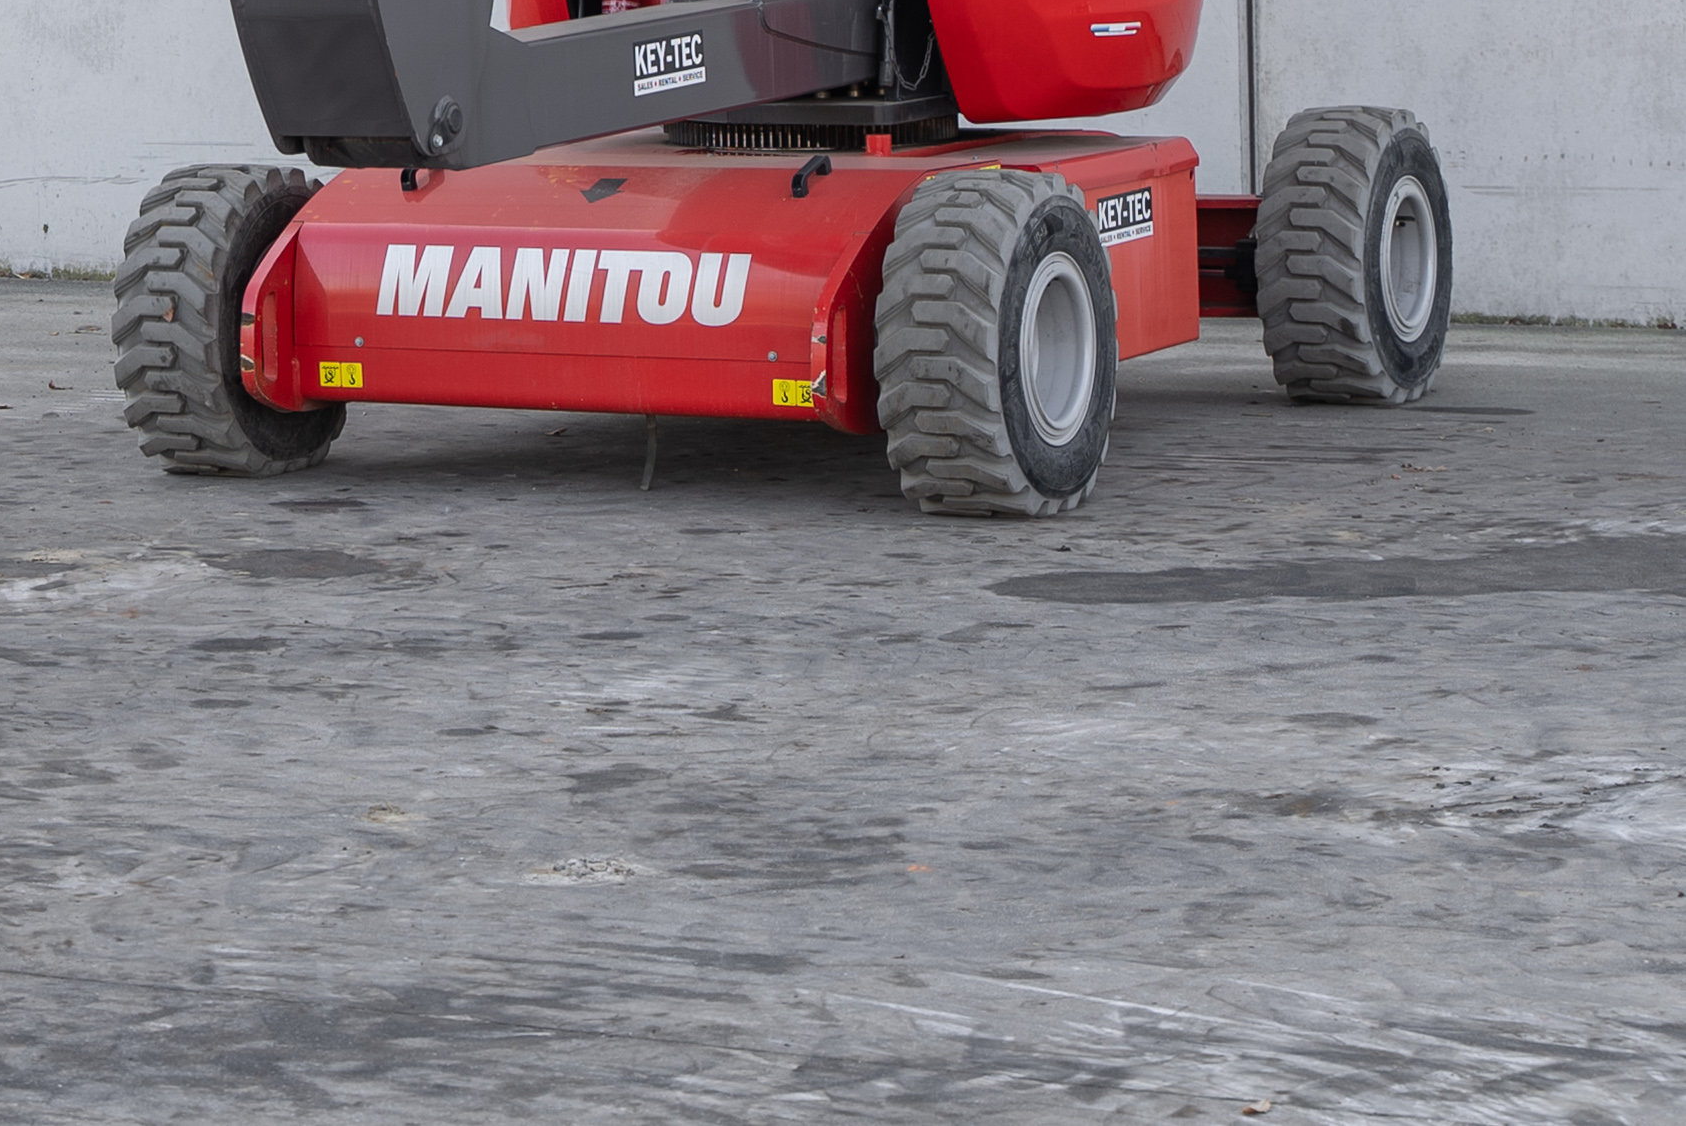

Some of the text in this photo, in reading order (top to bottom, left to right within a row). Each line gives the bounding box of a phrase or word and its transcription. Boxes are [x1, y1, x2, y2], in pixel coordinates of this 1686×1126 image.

[635, 34, 703, 77] KEY-TEC
[1098, 191, 1151, 231] KEY-TEC
[376, 243, 753, 327] MANITOU
